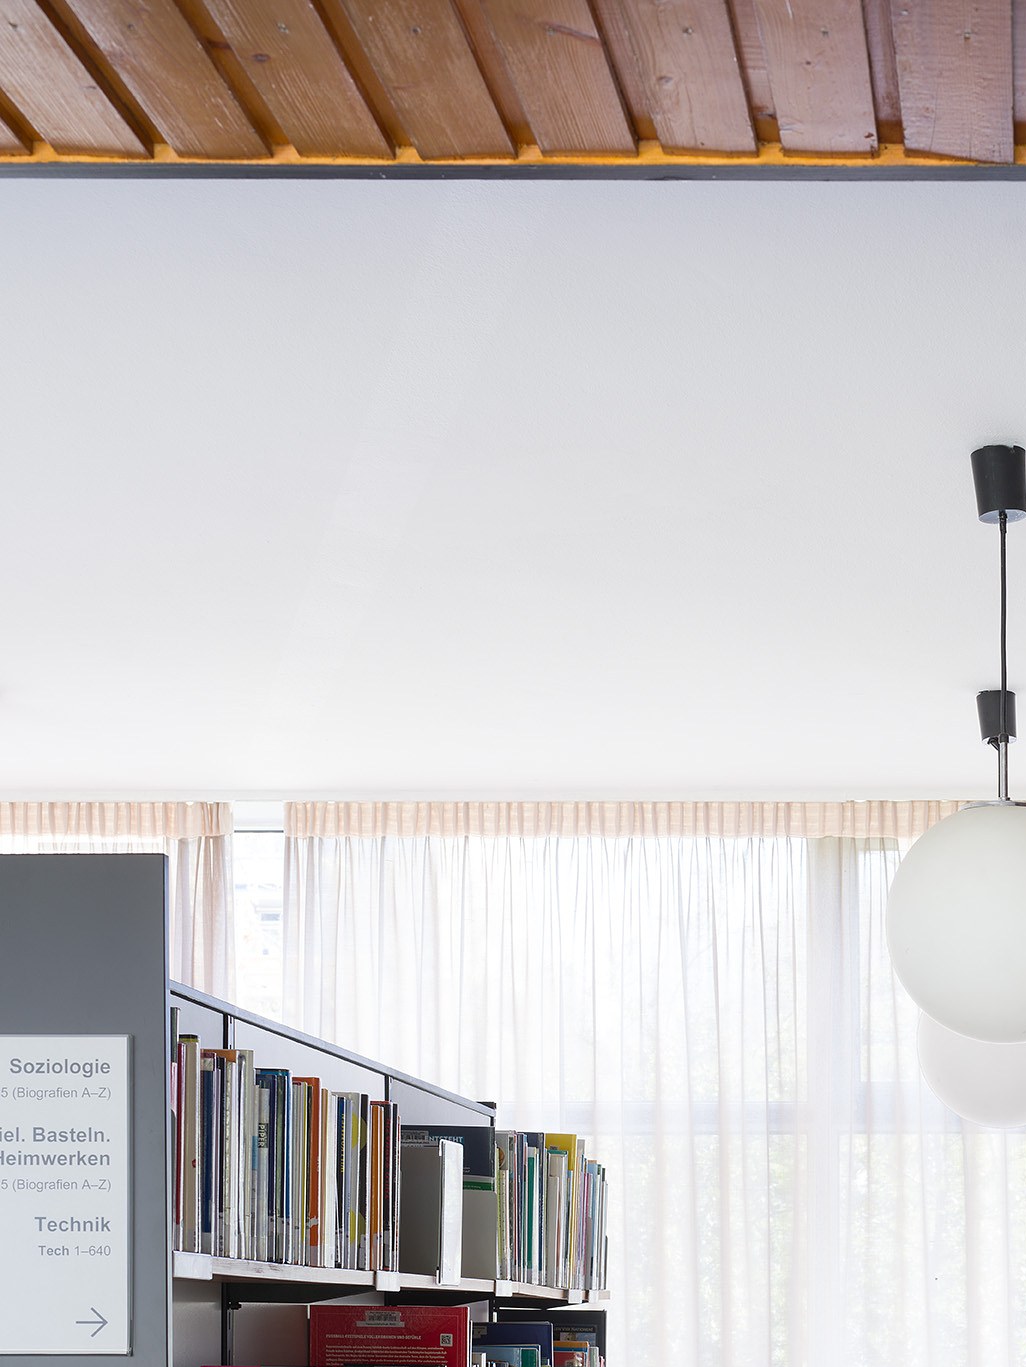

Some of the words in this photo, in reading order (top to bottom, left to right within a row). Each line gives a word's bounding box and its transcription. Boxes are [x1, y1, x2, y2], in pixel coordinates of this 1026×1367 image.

[9, 1058, 111, 1078] Soziologie
[0, 1087, 8, 1098] 5
[12, 1087, 78, 1101] (Biografien
[32, 1127, 111, 1142] Basteln.
[257, 1124, 266, 1148] PIPER
[0, 1179, 8, 1190] 5
[12, 1179, 78, 1193] (Biografien
[35, 1216, 111, 1232] Technik
[38, 1245, 70, 1256] Tech
